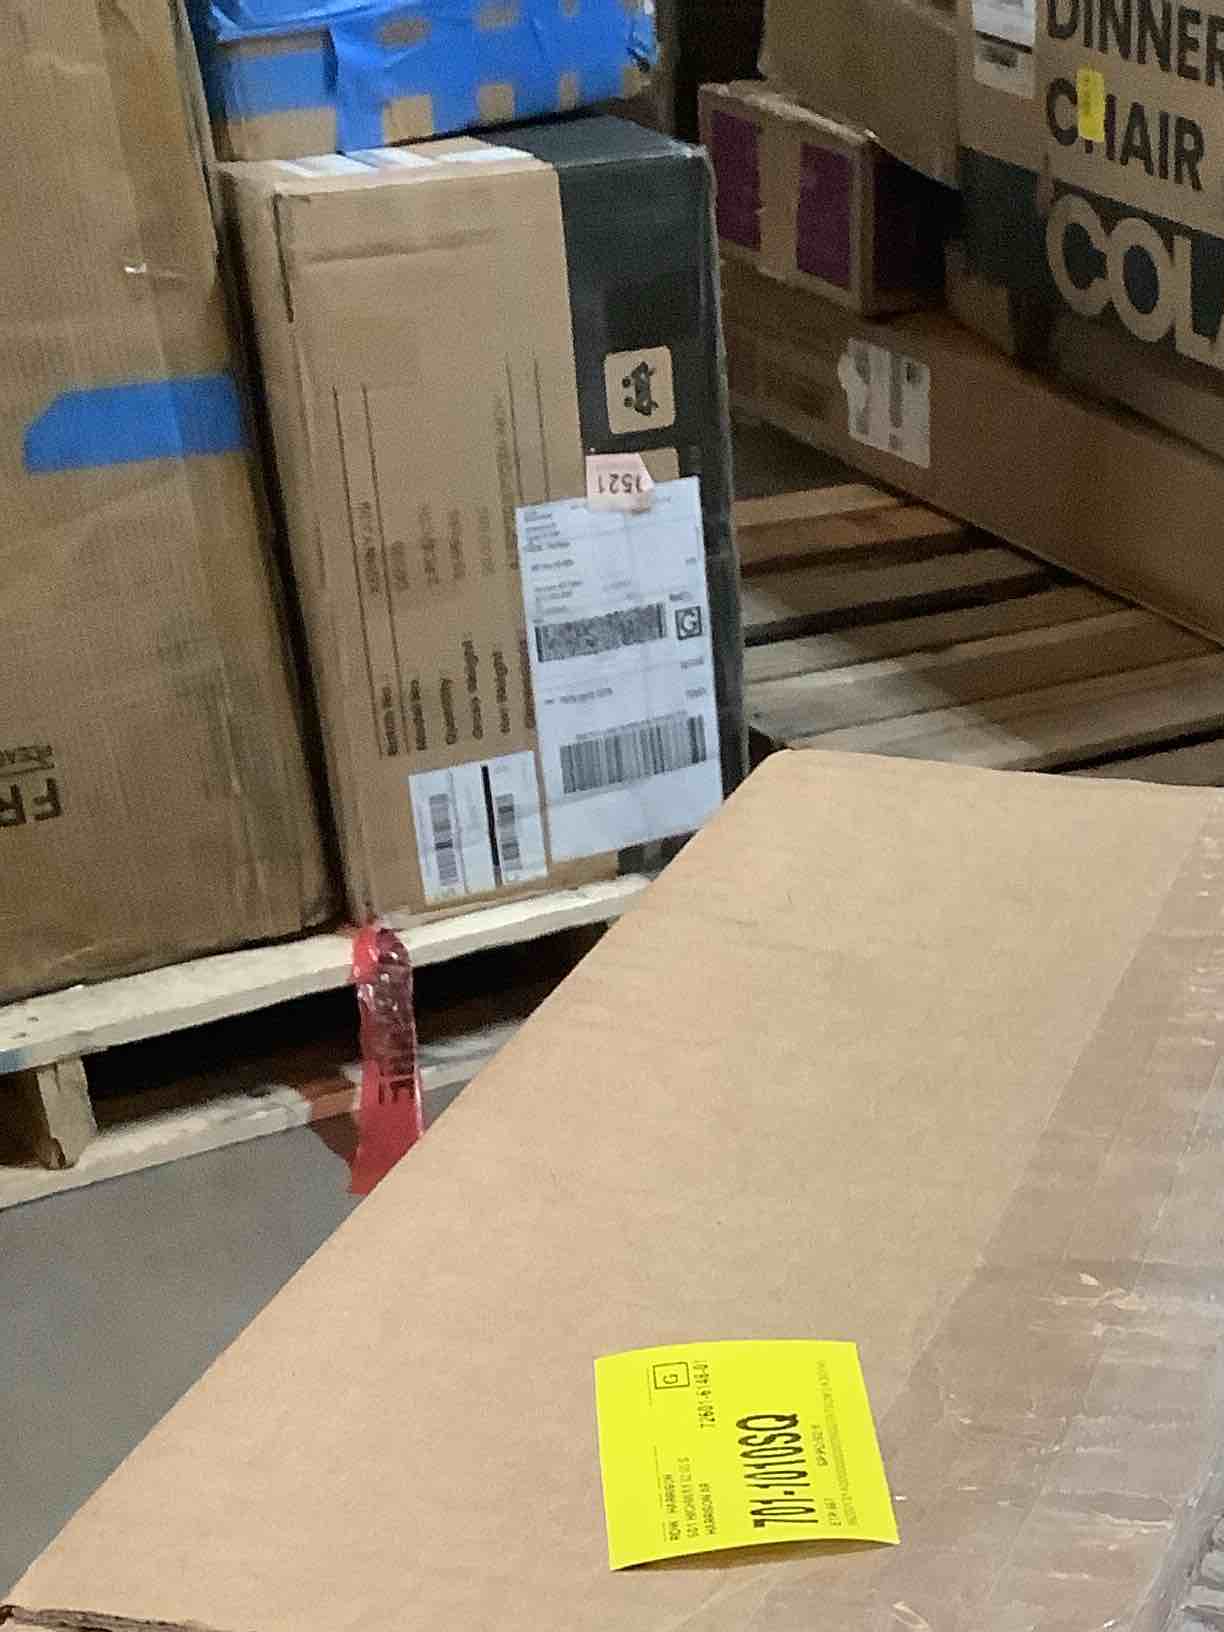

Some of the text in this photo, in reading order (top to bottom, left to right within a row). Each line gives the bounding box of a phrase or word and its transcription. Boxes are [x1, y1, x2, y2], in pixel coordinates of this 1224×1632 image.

[598, 473, 643, 494] 1521
[663, 1374, 678, 1385] G
[735, 1413, 819, 1529] 701-1010SQ
